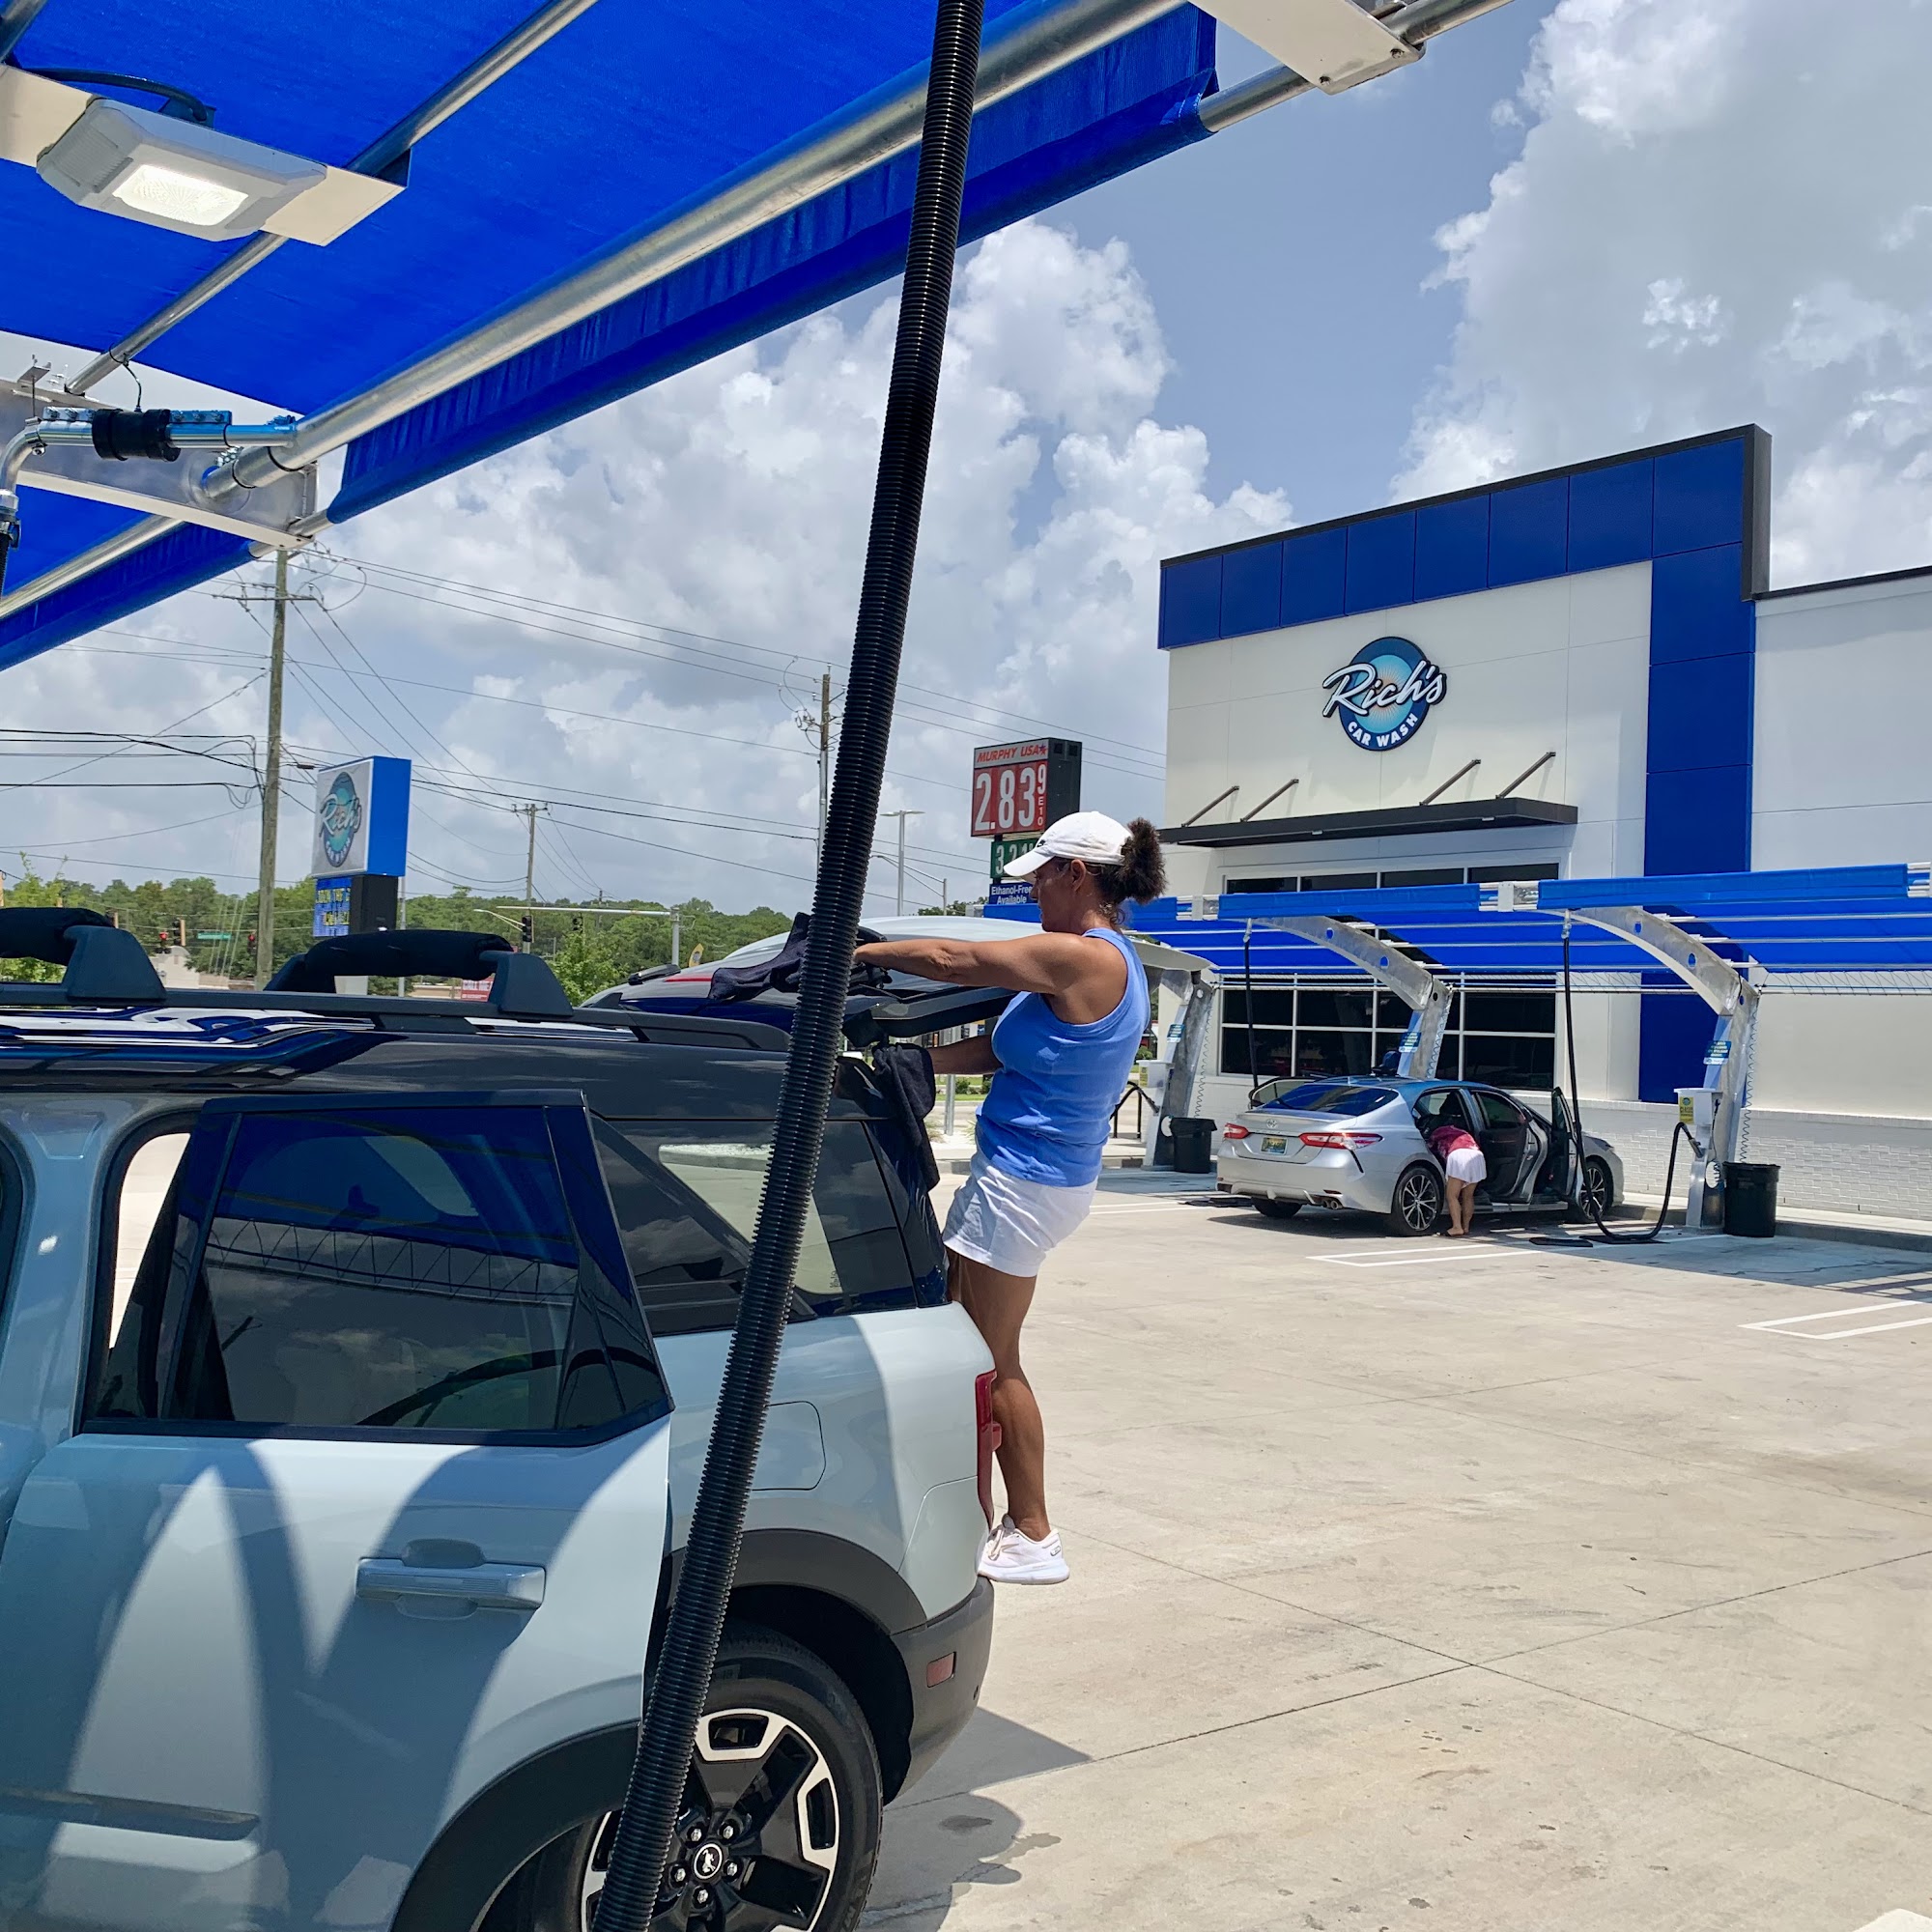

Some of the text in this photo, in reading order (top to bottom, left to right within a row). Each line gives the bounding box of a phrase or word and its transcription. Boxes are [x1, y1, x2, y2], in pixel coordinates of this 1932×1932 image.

[1322, 660, 1445, 716] Rich's
[1348, 713, 1418, 748] CAR WASH
[977, 745, 1040, 763] MURPHY USA
[996, 895, 1027, 905] Available
